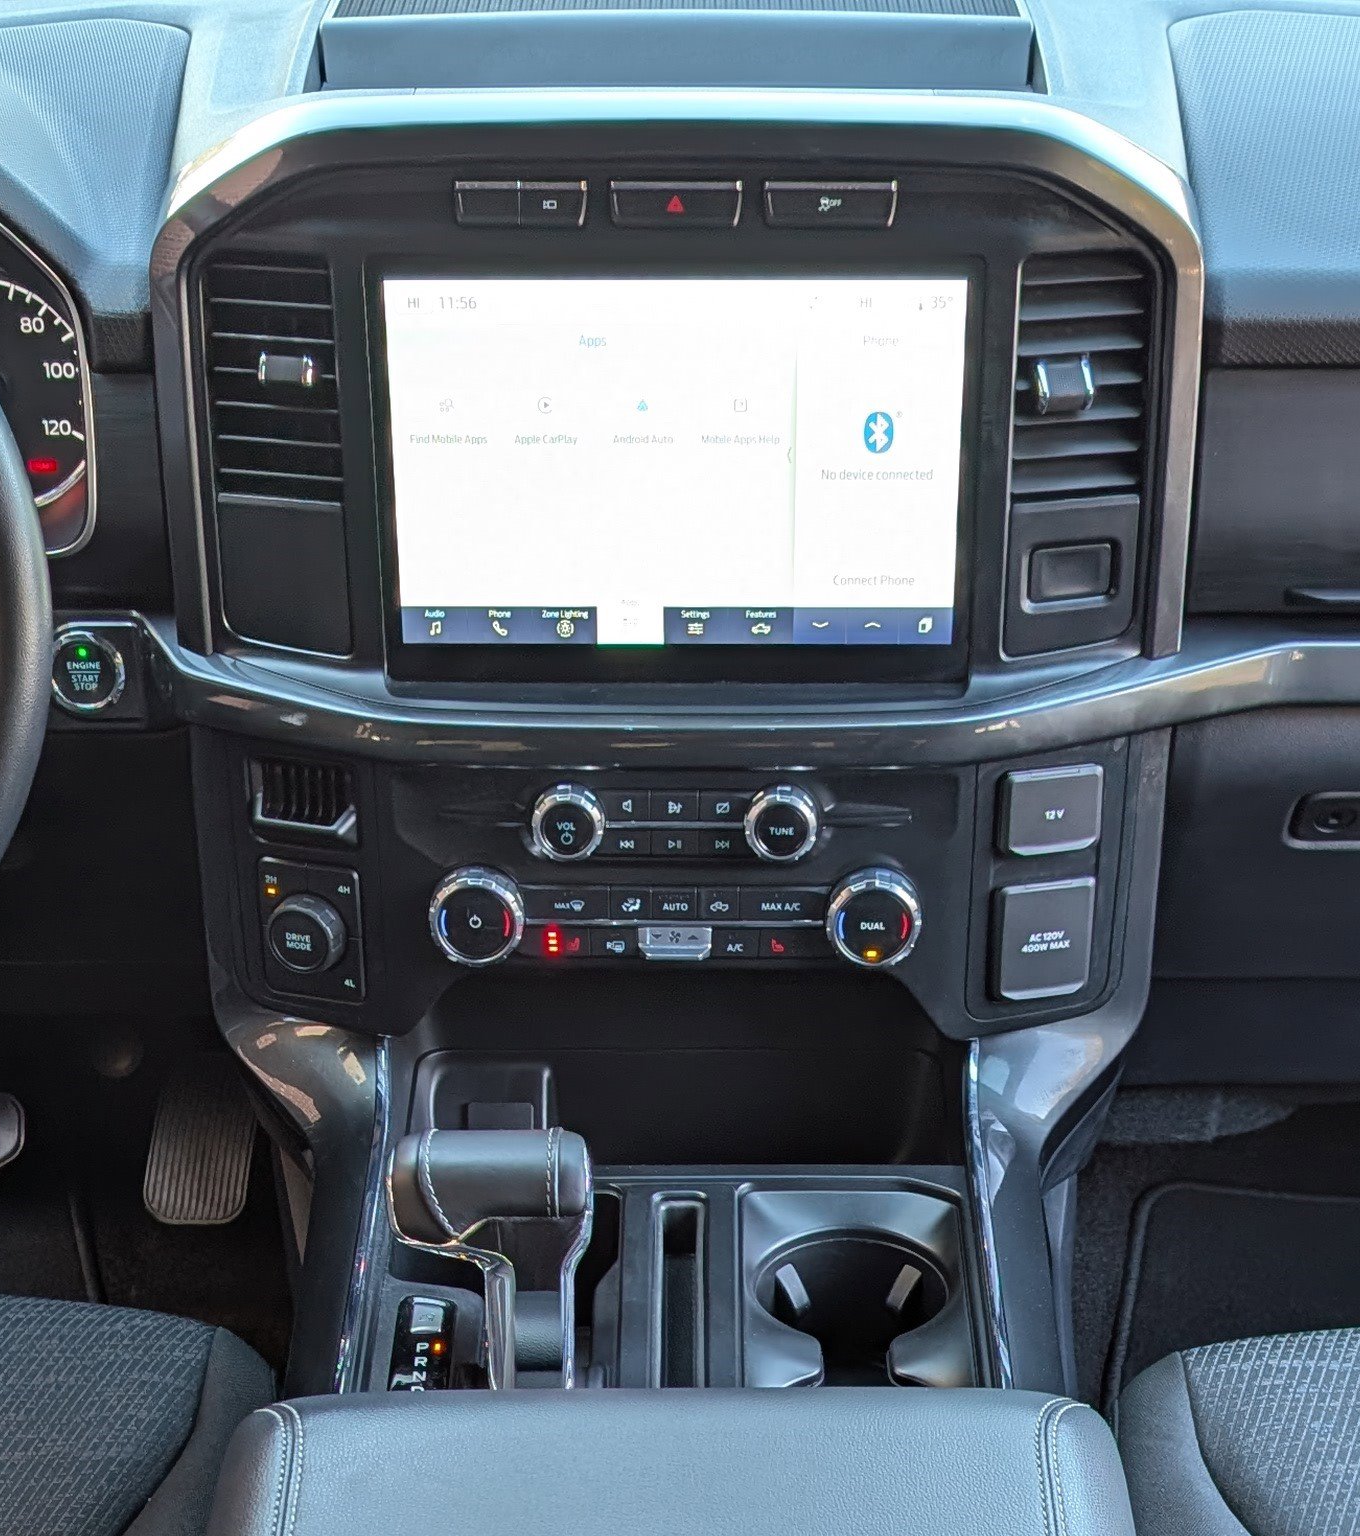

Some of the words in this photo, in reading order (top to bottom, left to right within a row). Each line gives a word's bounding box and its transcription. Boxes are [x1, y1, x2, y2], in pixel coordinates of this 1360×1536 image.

[439, 296, 477, 310] 11:56
[20, 317, 45, 334] 80
[578, 335, 607, 348] Apps
[43, 362, 75, 378] 100
[42, 419, 72, 436] 120
[409, 434, 430, 444] Find
[432, 434, 462, 444] Mobile
[464, 434, 488, 445] Apps
[515, 434, 541, 446] Apple
[543, 434, 578, 446] CarPlay
[613, 434, 649, 444] Android
[652, 434, 674, 444] Auto
[701, 434, 732, 444] Mobile
[734, 434, 757, 445] Apps
[759, 434, 780, 445] Help
[821, 469, 837, 480] No
[839, 469, 874, 480] device
[876, 469, 934, 480] connected
[833, 574, 877, 586] Connect
[880, 574, 915, 586] Phone
[425, 609, 445, 618] Audio
[488, 609, 511, 618] Phone
[541, 610, 559, 618] Zone
[560, 610, 589, 620] Lighting
[681, 609, 710, 620] Settings
[745, 610, 777, 619] Features
[66, 661, 101, 670] ENGINE
[71, 674, 100, 683] START
[74, 682, 98, 691] STOP
[556, 822, 576, 831] VOL
[769, 826, 794, 836] TUNE
[337, 885, 351, 894] 4H
[662, 903, 689, 911] AUTO
[761, 902, 783, 911] MAX
[784, 902, 801, 912] A/C
[860, 922, 885, 931] DUAL
[285, 932, 311, 943] DRIVE
[1029, 933, 1042, 943] AC
[1043, 930, 1065, 941] 120V
[286, 941, 312, 952] MODE
[726, 943, 744, 952] A/C
[1021, 943, 1048, 953] 400W
[1050, 940, 1070, 950] MAX
[344, 979, 356, 989] 4L
[416, 1342, 429, 1353] P
[414, 1357, 428, 1367] R
[412, 1371, 427, 1382] N
